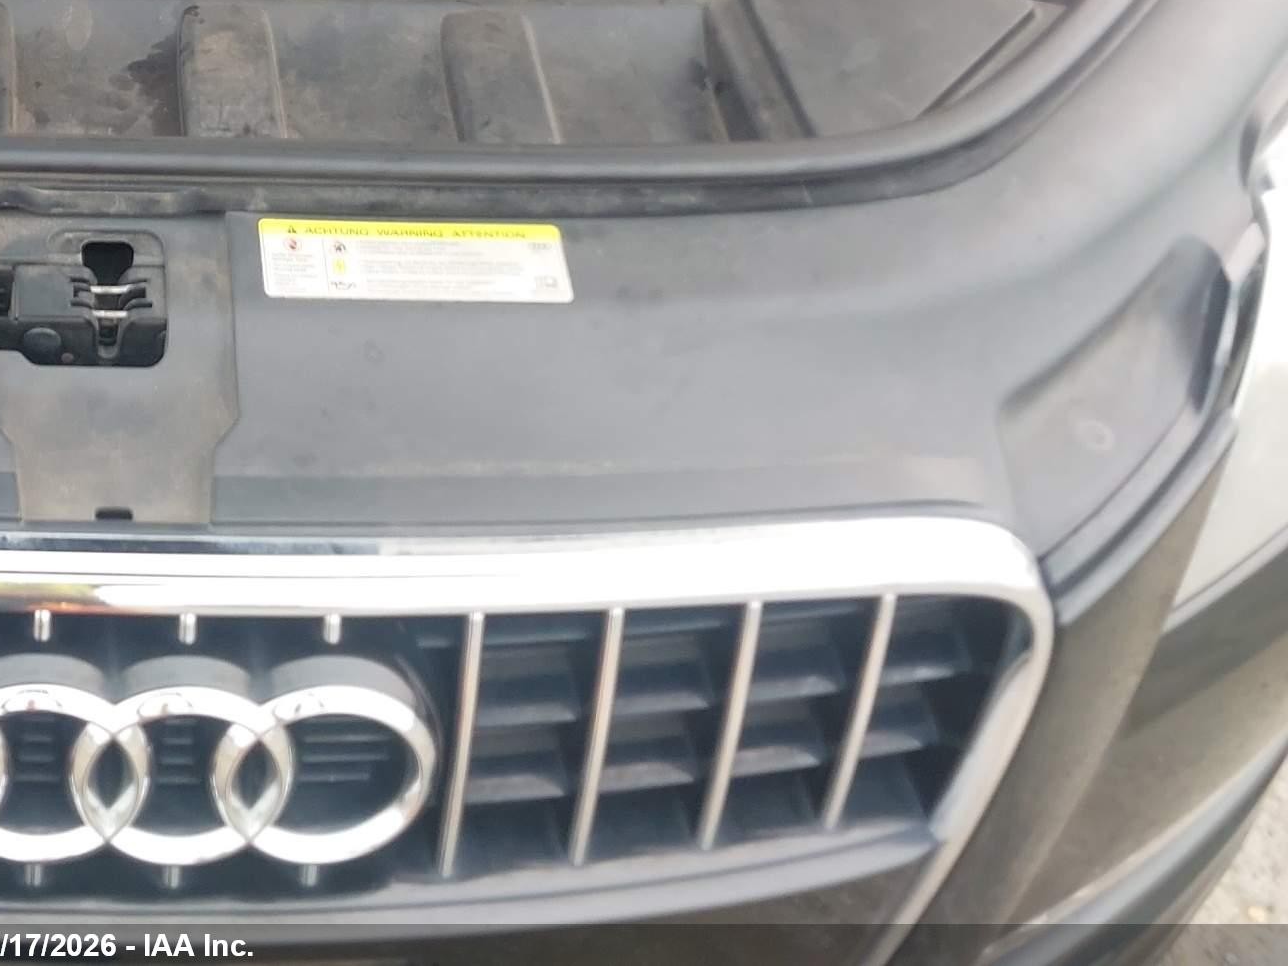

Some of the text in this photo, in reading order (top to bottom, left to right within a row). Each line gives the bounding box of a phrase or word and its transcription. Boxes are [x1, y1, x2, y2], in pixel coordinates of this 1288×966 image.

[304, 226, 525, 239] ACHTUNG WARNING ATTENTION
